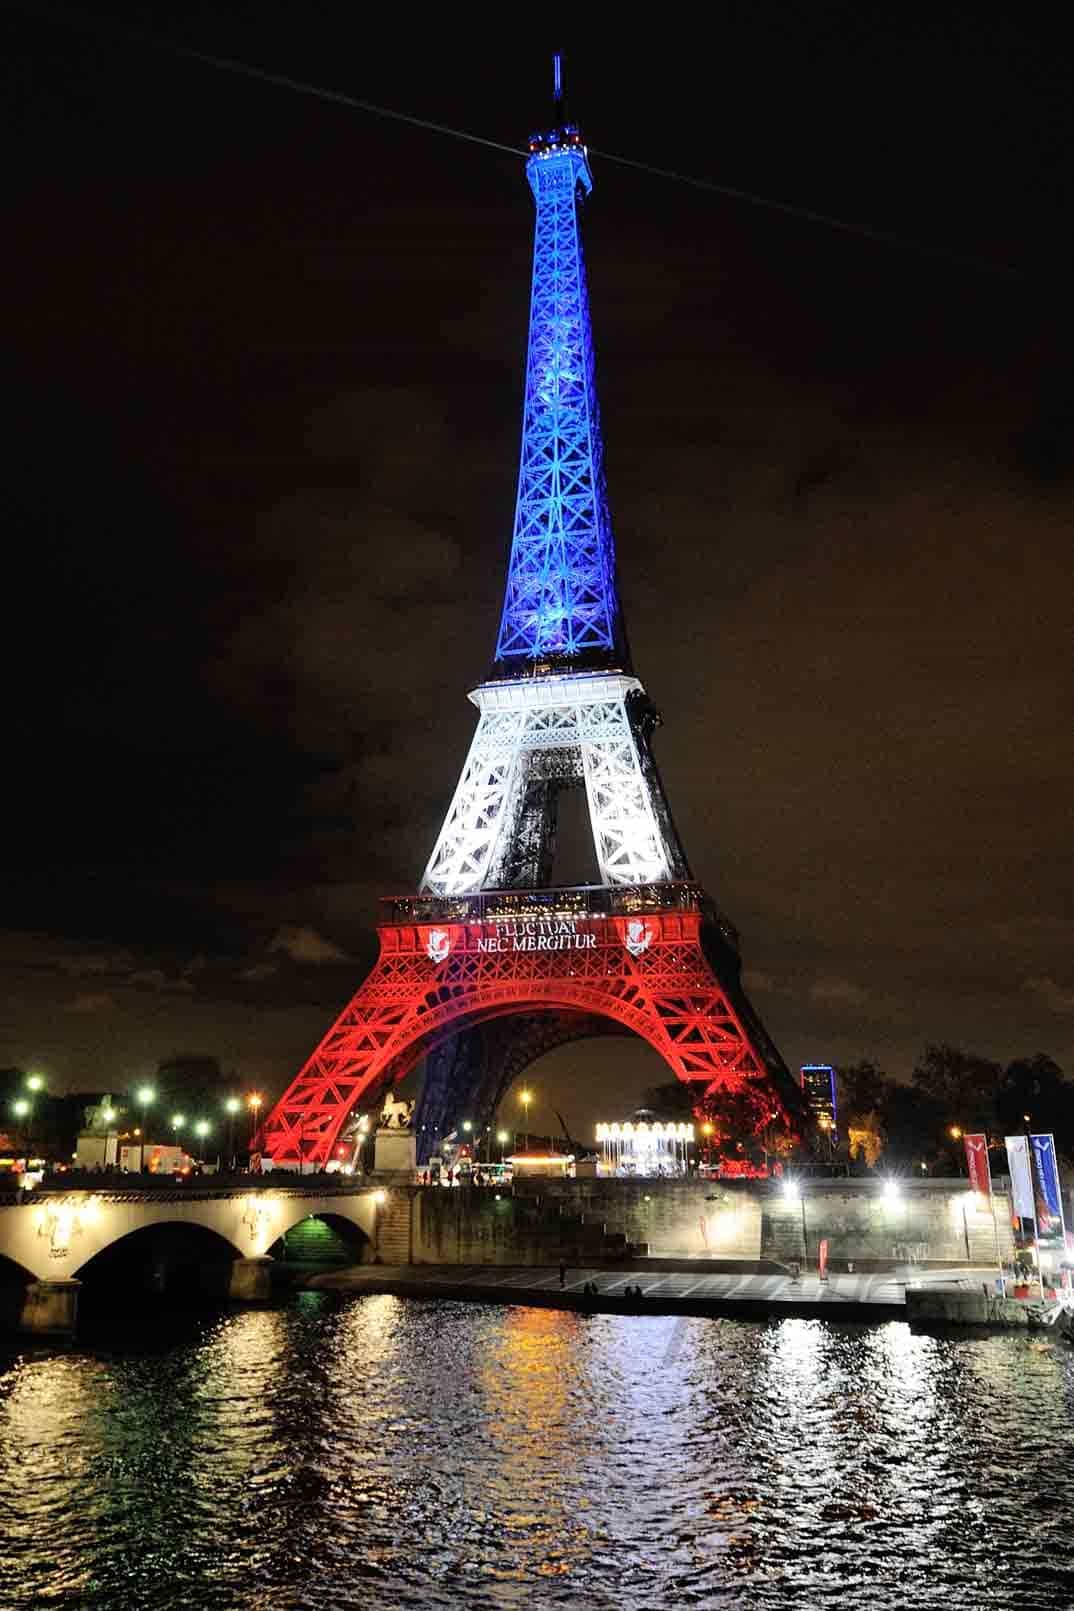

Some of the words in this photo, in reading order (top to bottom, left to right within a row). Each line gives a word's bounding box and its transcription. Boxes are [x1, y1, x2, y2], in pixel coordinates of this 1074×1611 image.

[495, 921, 577, 937] FLUCTUAT
[477, 937, 509, 953] NEC
[512, 934, 597, 951] MERGITUR
